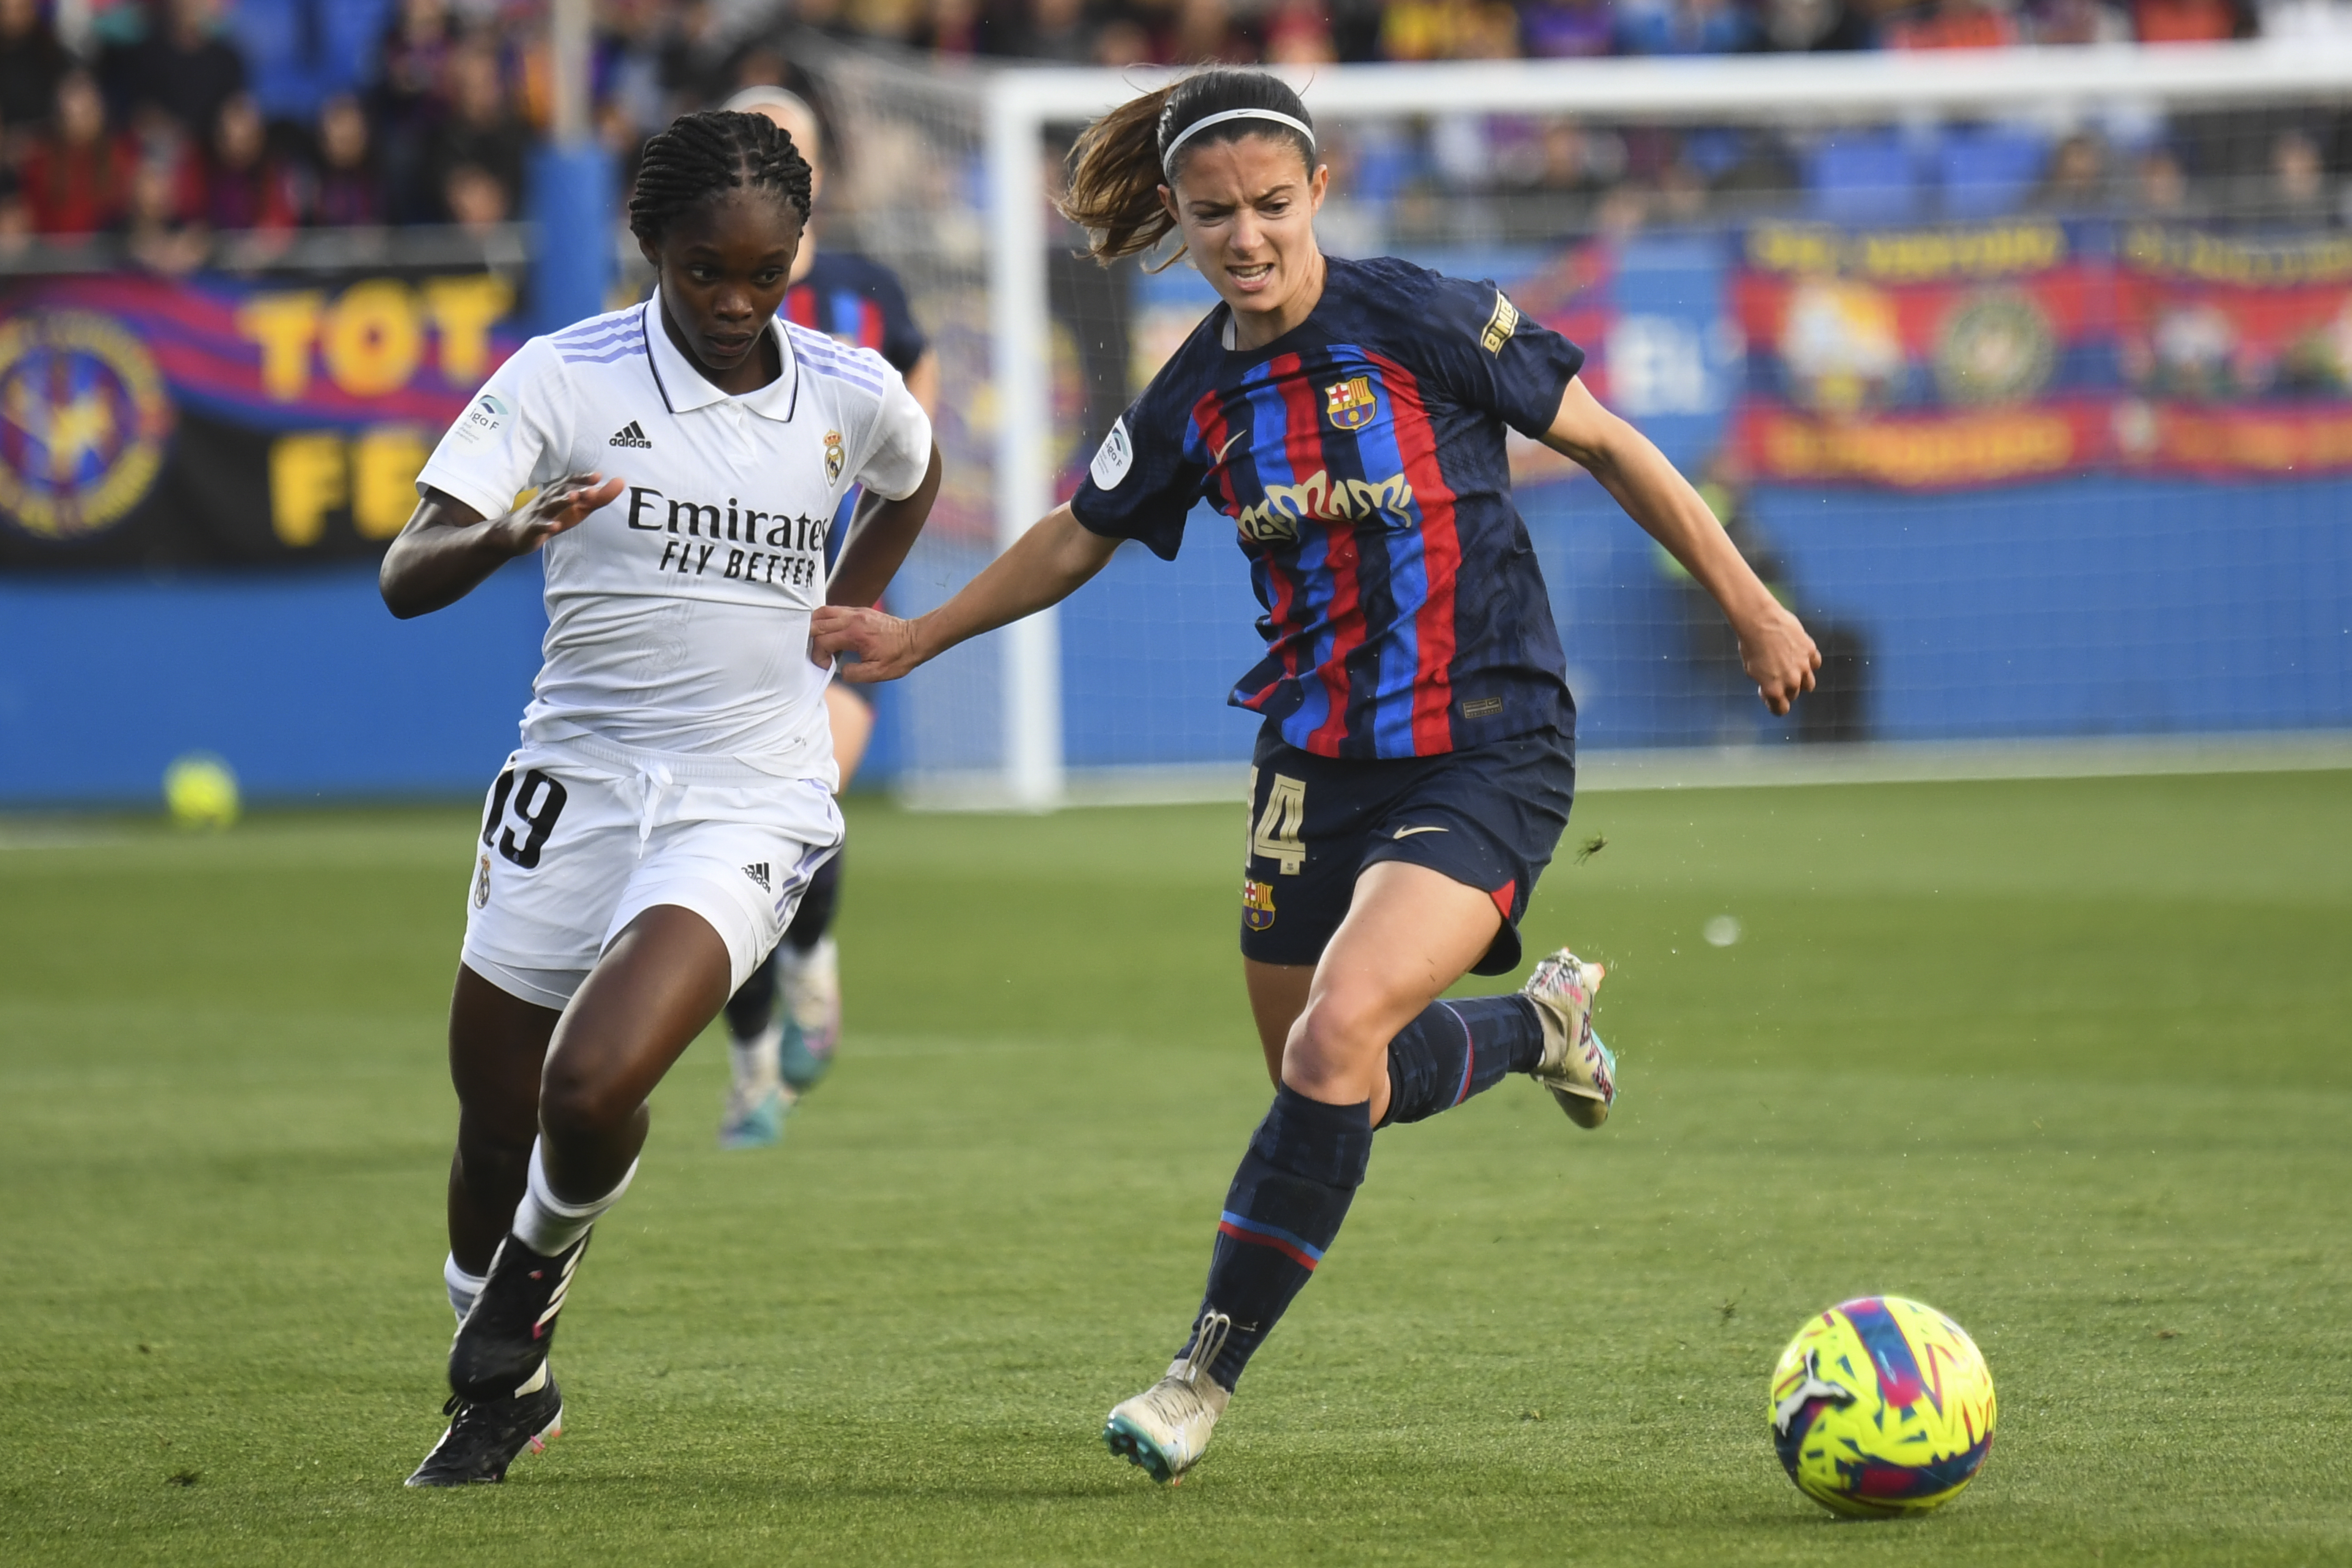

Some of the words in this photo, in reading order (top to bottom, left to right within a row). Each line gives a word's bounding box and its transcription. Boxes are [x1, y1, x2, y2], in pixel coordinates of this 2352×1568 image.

[237, 273, 512, 402] TOT
[1484, 294, 1514, 353] BIMB
[609, 436, 652, 449] adidas
[1105, 440, 1117, 461] iga
[628, 486, 828, 552] Emirates
[659, 541, 715, 575] FLY
[723, 549, 815, 588] BETTER
[482, 755, 567, 869] 19
[741, 866, 771, 894] adidas
